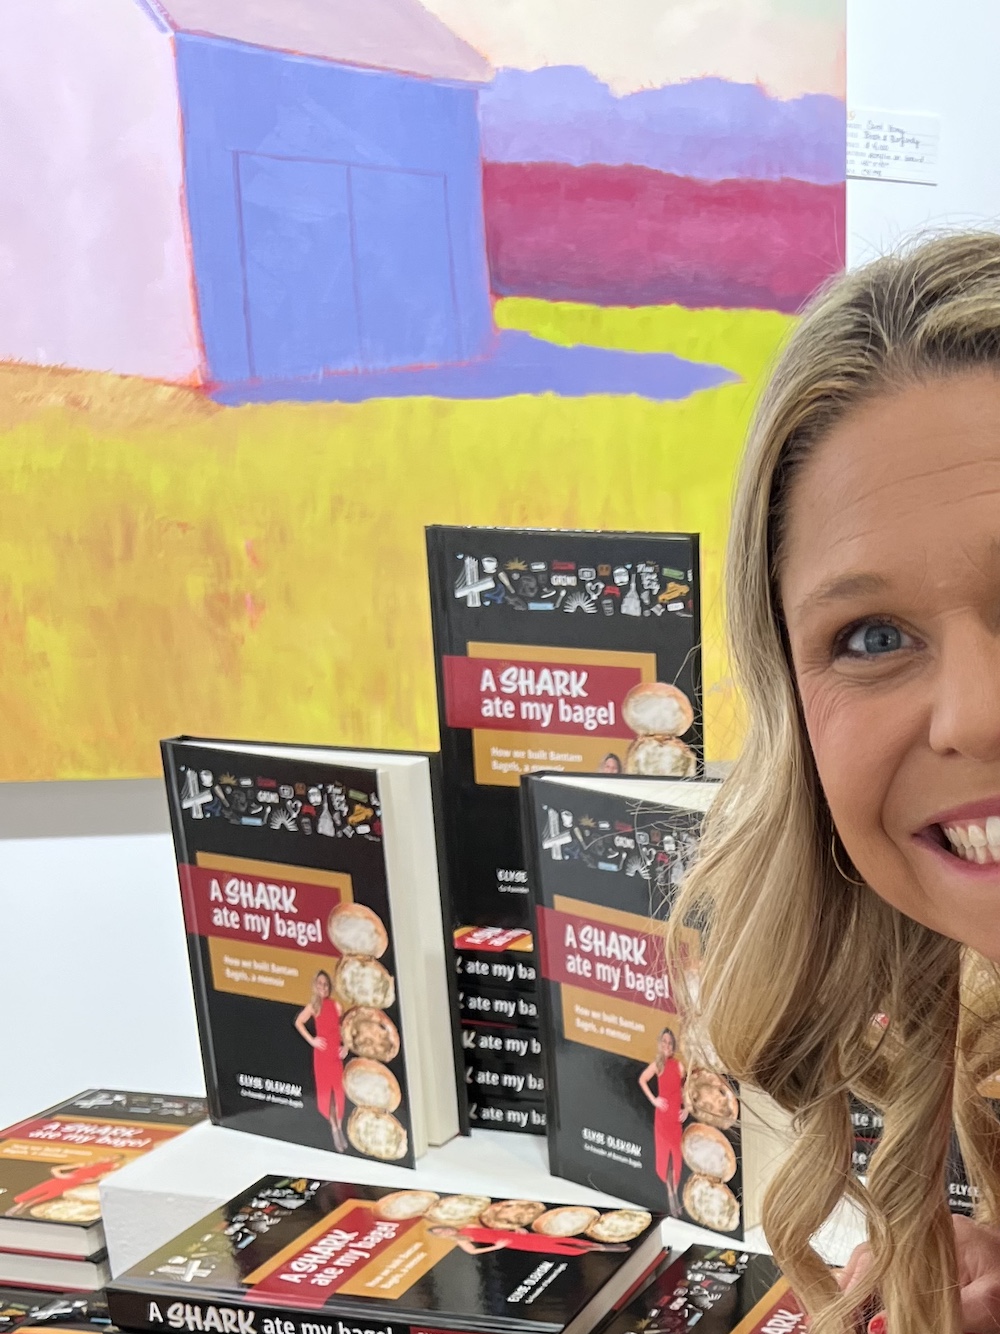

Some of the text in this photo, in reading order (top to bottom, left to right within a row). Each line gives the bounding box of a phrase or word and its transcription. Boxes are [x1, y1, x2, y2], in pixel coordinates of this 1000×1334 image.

[480, 666, 588, 697] A SHARK
[481, 696, 614, 730] ate my bagel
[210, 878, 298, 913] A SHARK
[212, 906, 322, 946] ate my bagel
[565, 924, 577, 948] A
[579, 925, 647, 965] SHARK
[465, 959, 490, 976] ate
[491, 963, 515, 982] my
[566, 953, 591, 977] ate
[595, 961, 620, 991] my
[624, 963, 669, 1001] bagel
[467, 995, 491, 1012] ate
[493, 999, 517, 1018] my
[478, 1034, 503, 1049] ate
[505, 1038, 529, 1057] my
[347, 1220, 400, 1250] bagel
[290, 1228, 360, 1273] SHARK
[332, 1248, 371, 1267] my
[279, 1273, 308, 1284] A
[310, 1266, 345, 1287] ate
[148, 1300, 164, 1324] A
